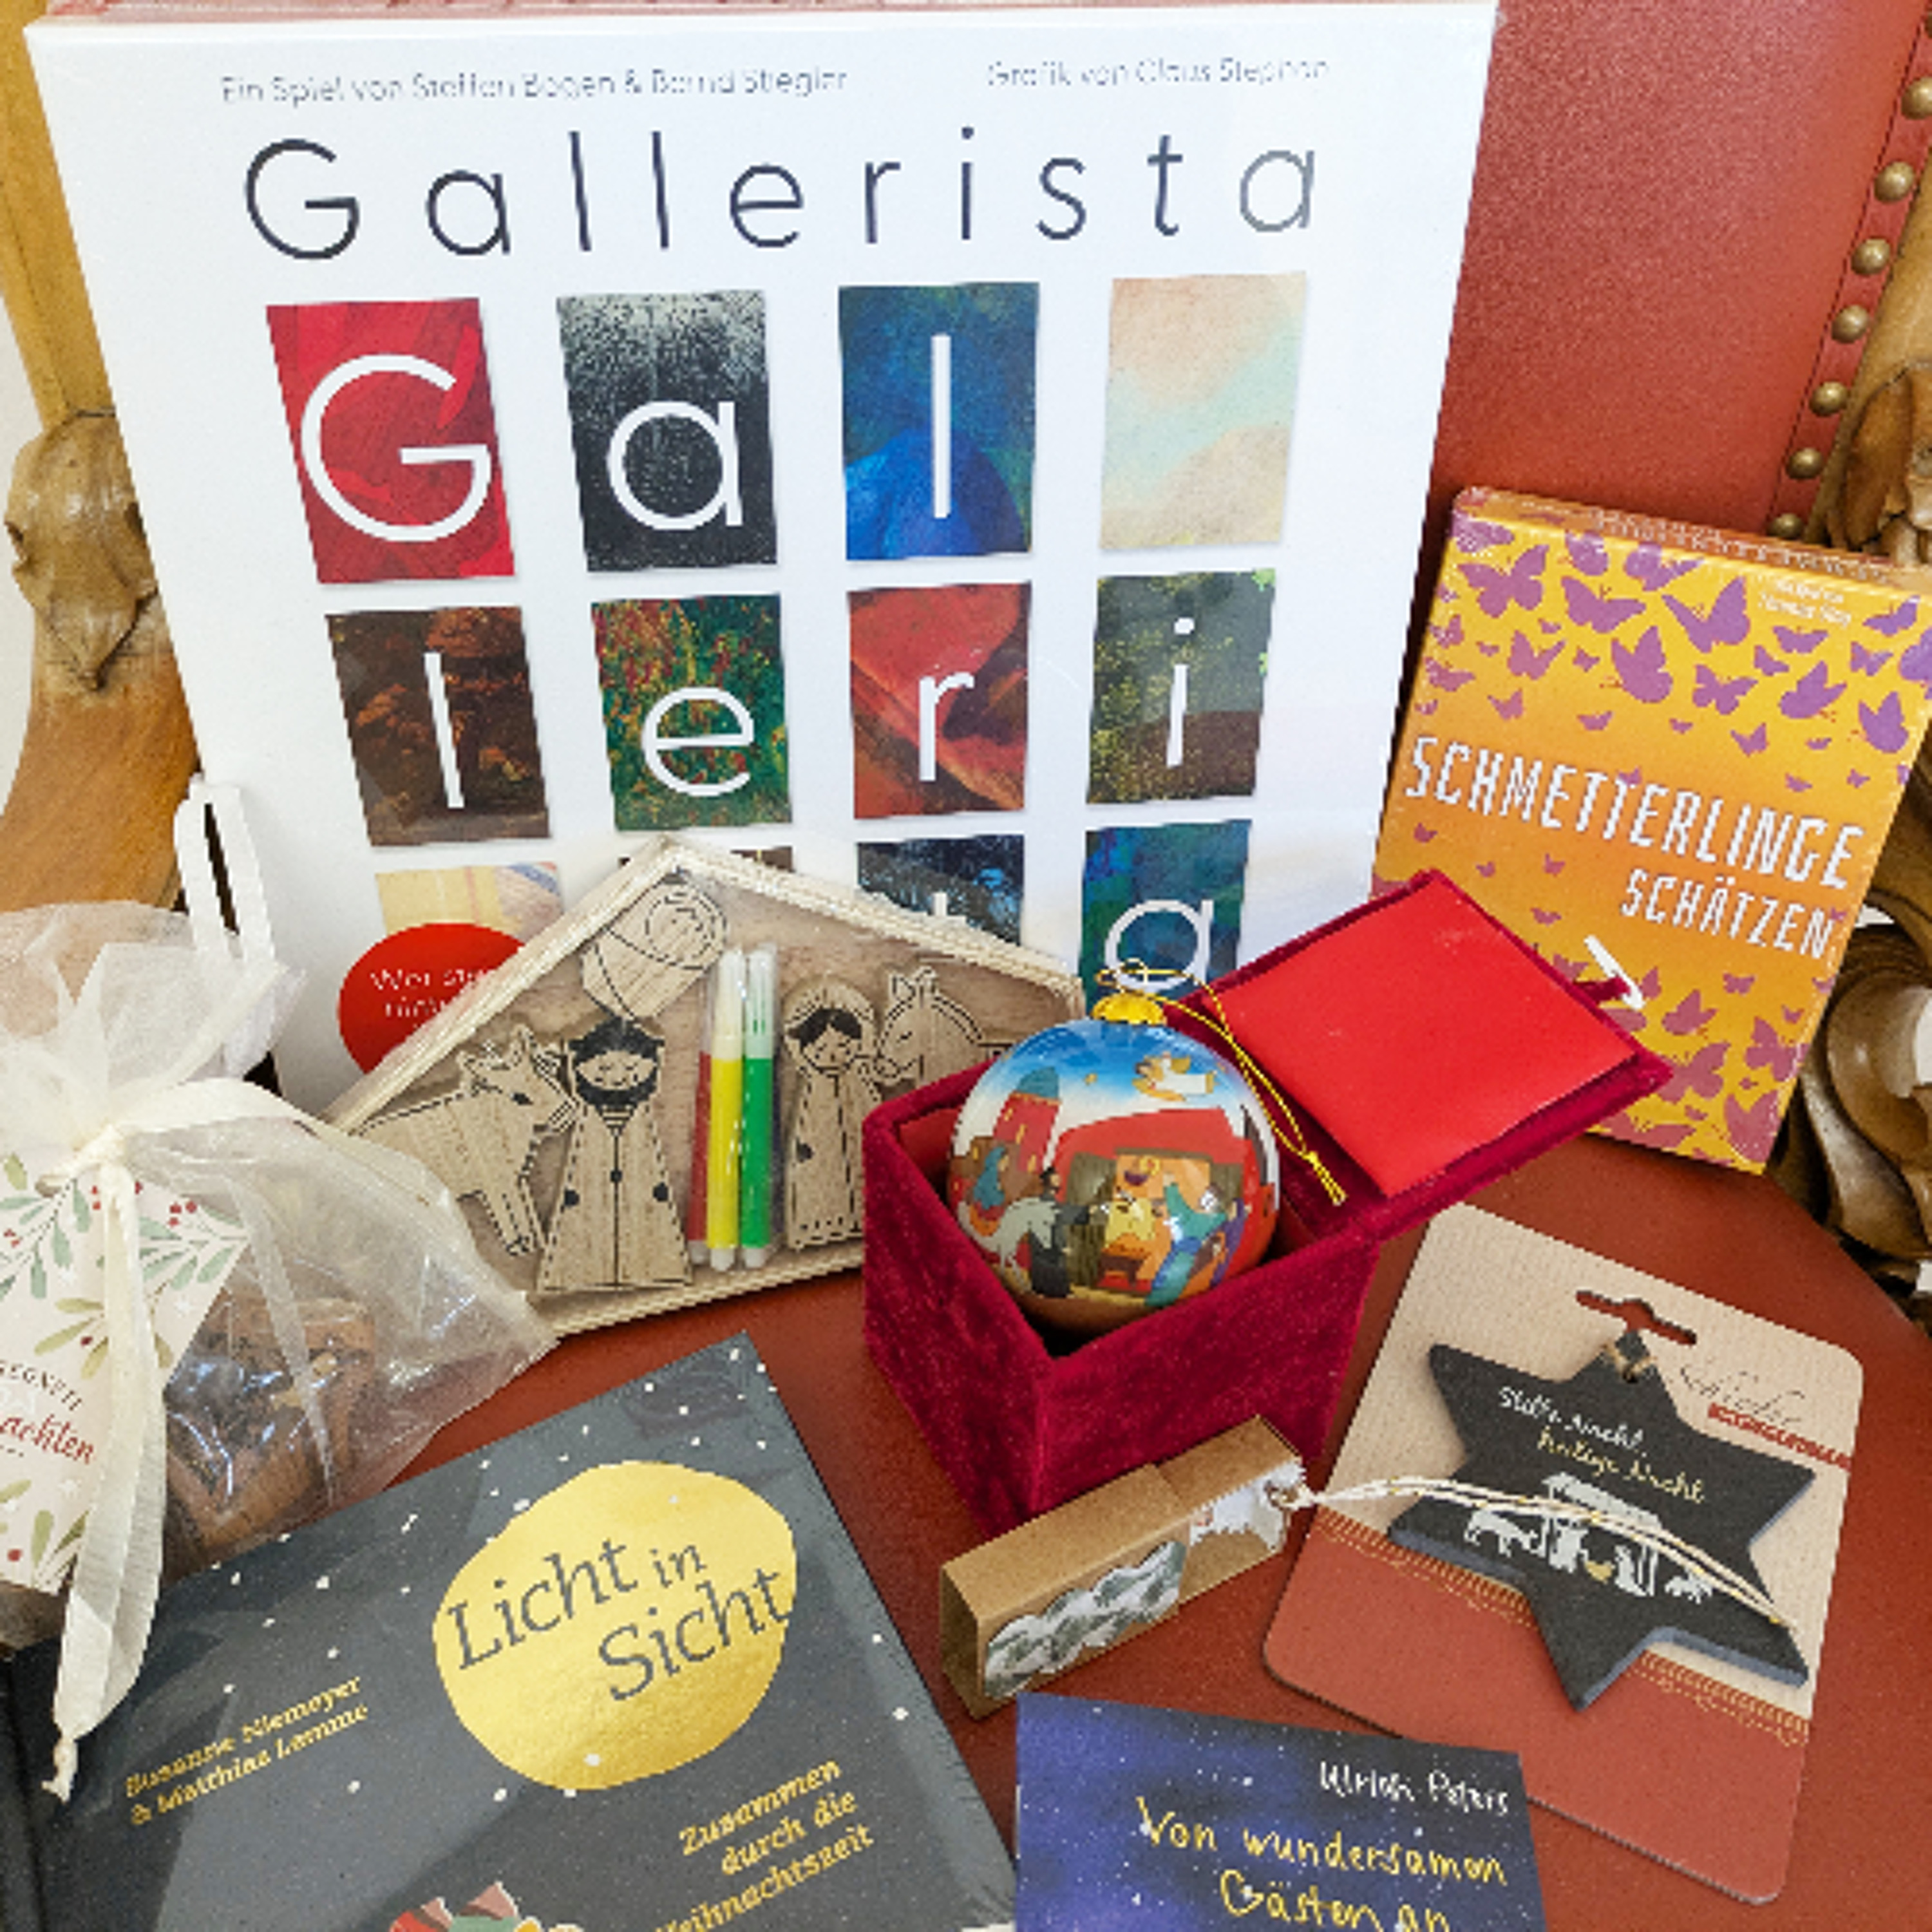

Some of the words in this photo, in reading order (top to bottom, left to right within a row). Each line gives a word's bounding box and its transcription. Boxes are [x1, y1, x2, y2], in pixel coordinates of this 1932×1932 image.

[245, 126, 1317, 260] Gallerista
[1406, 737, 1864, 889] SCHMETTERLINGE
[1621, 869, 1836, 960] SCHÄTZEN
[448, 1537, 639, 1671] Licht
[649, 1543, 707, 1589] in
[598, 1567, 791, 1701] Sicht
[131, 1803, 153, 1825] &
[679, 1759, 841, 1857] Zusammen
[721, 1815, 808, 1876] durch
[813, 1791, 858, 1829] die
[1135, 1795, 1218, 1851] Von
